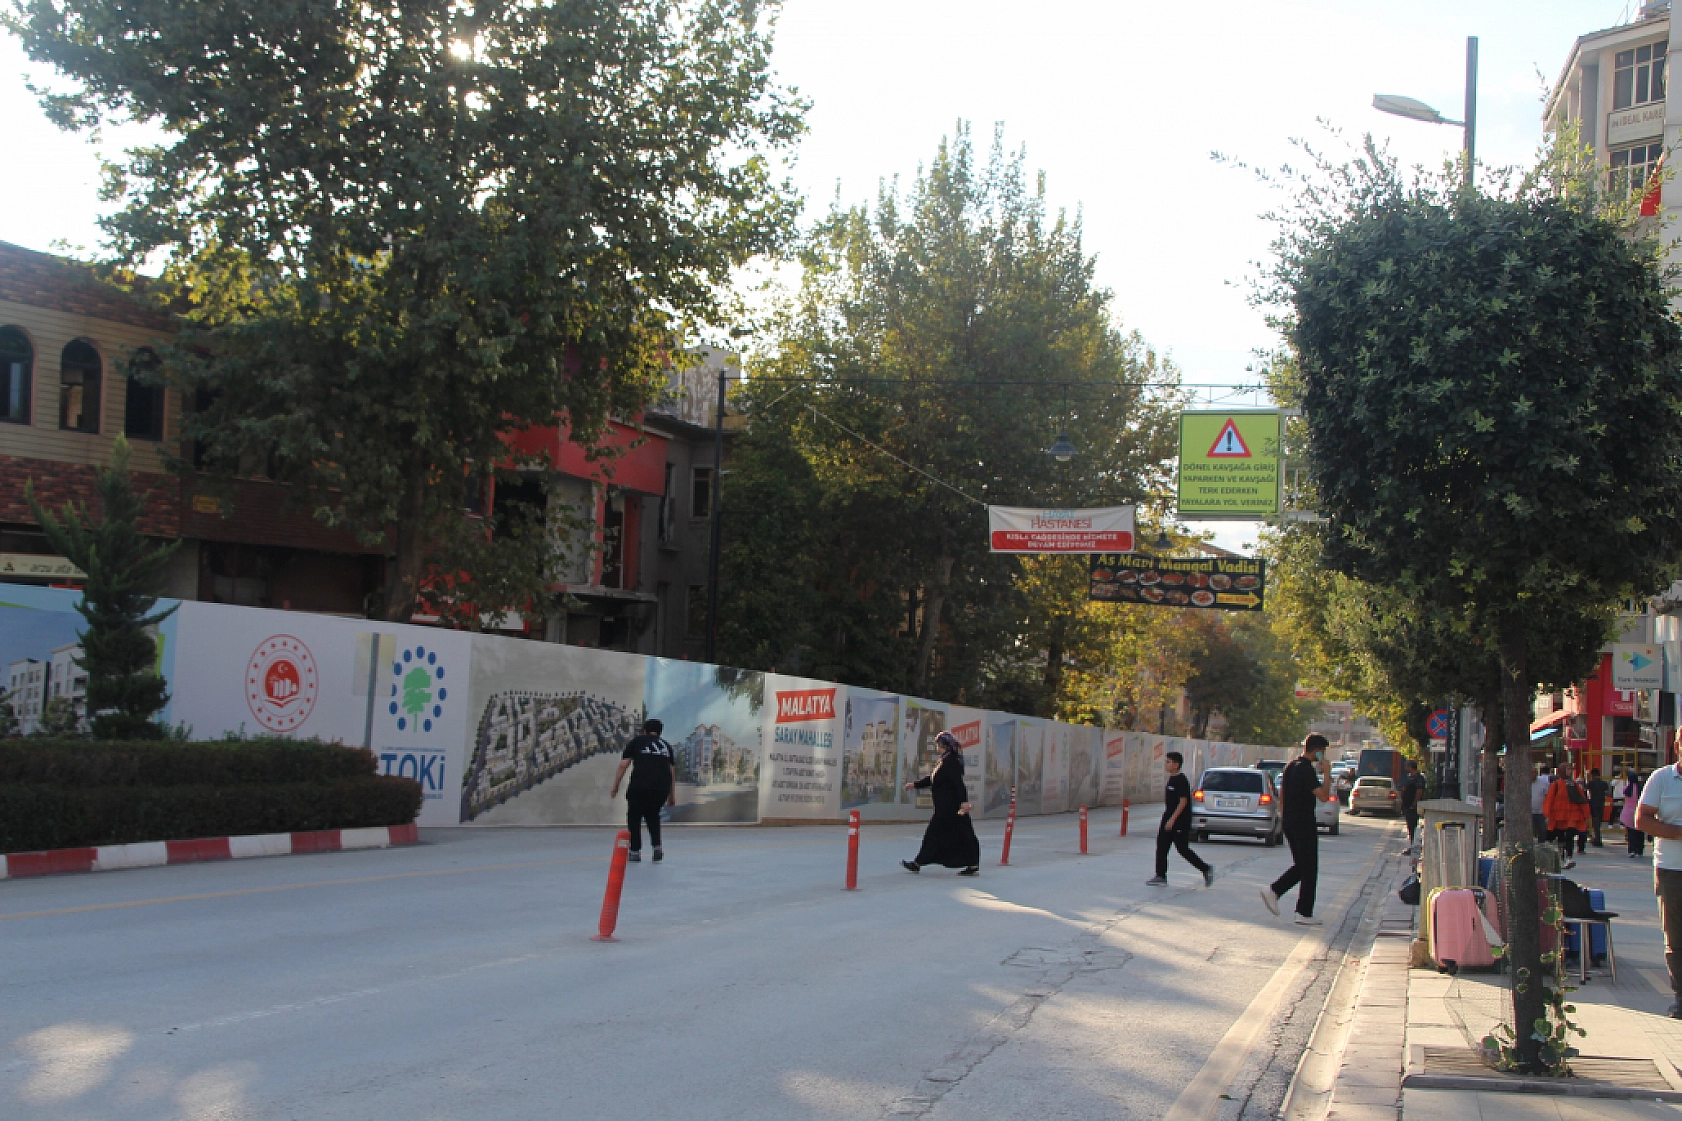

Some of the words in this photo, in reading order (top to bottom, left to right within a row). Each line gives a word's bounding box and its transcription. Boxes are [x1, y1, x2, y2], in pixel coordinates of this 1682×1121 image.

[1183, 462, 1211, 471] DÖNEL
[1212, 462, 1251, 472] KAVŞAĞA
[1253, 462, 1275, 472] GİRİŞ
[1083, 532, 1118, 540] HİZMETE
[1027, 540, 1055, 548] DEVAM
[1097, 554, 1116, 566] As
[1158, 558, 1214, 573] Mangal
[1217, 559, 1260, 573] Vadisi
[781, 694, 831, 717] MALATYA
[774, 727, 798, 744] SARAY
[798, 728, 835, 748] MAHALLESİ
